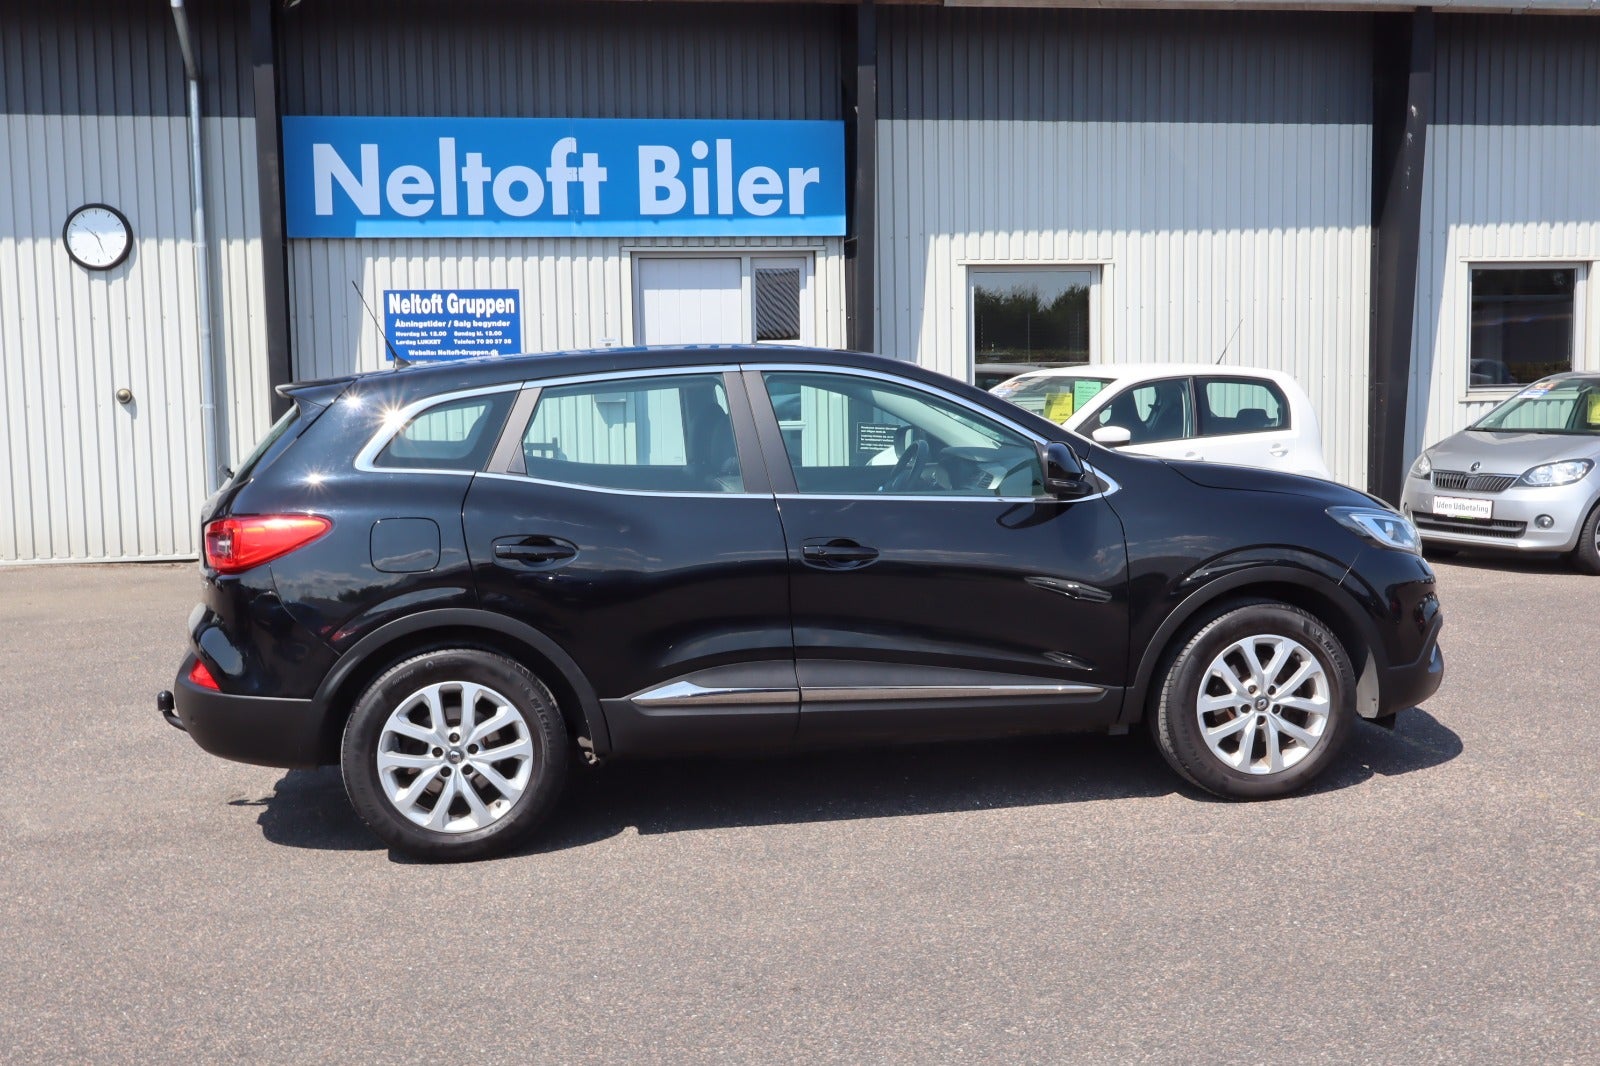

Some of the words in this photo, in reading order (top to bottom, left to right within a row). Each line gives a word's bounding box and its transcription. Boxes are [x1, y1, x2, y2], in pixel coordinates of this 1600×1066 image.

[312, 137, 608, 218] Neltoft
[638, 138, 820, 217] Biler
[388, 293, 443, 314] Neltoft
[446, 293, 515, 317] Gruppen
[395, 319, 447, 328] Åbningstider
[447, 320, 452, 328] /
[453, 319, 471, 328] Salg
[472, 319, 510, 329] begynder
[1436, 500, 1453, 509] Uden
[1453, 502, 1489, 514] Udbetaling
